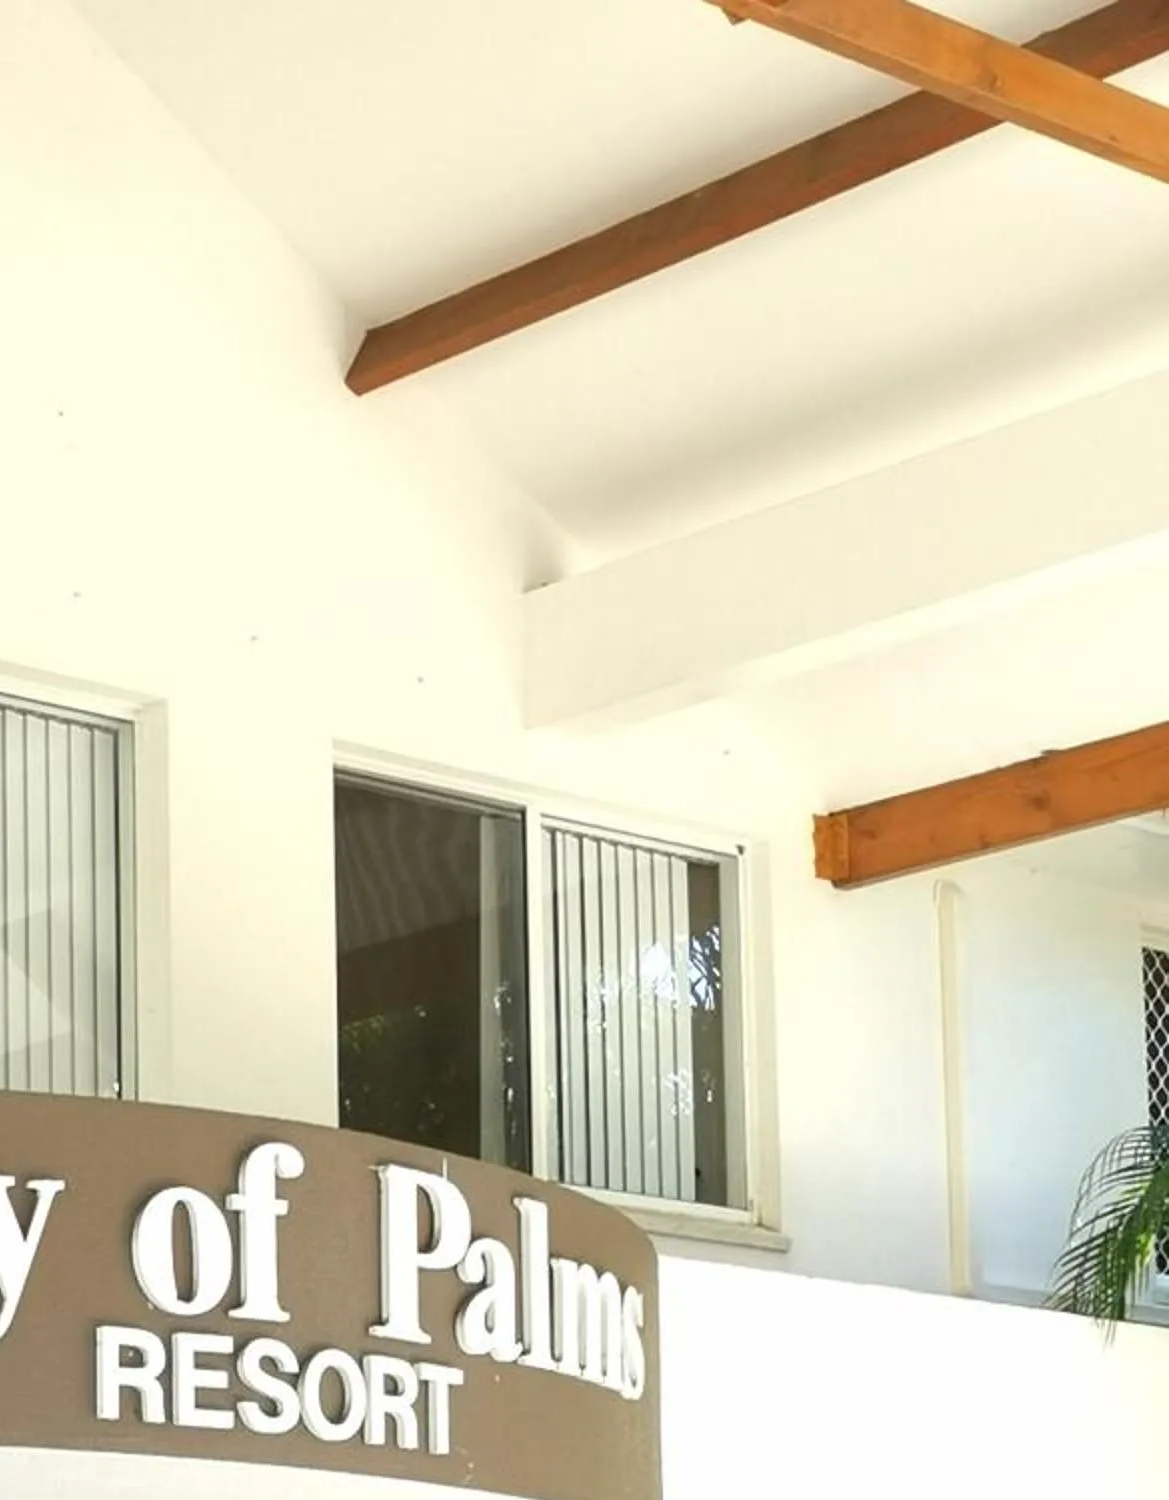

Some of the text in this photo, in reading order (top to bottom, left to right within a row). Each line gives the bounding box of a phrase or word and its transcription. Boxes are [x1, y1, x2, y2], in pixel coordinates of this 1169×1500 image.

[131, 1140, 305, 1323] of
[368, 1162, 646, 1400] Palms
[95, 1325, 464, 1456] RESORT
